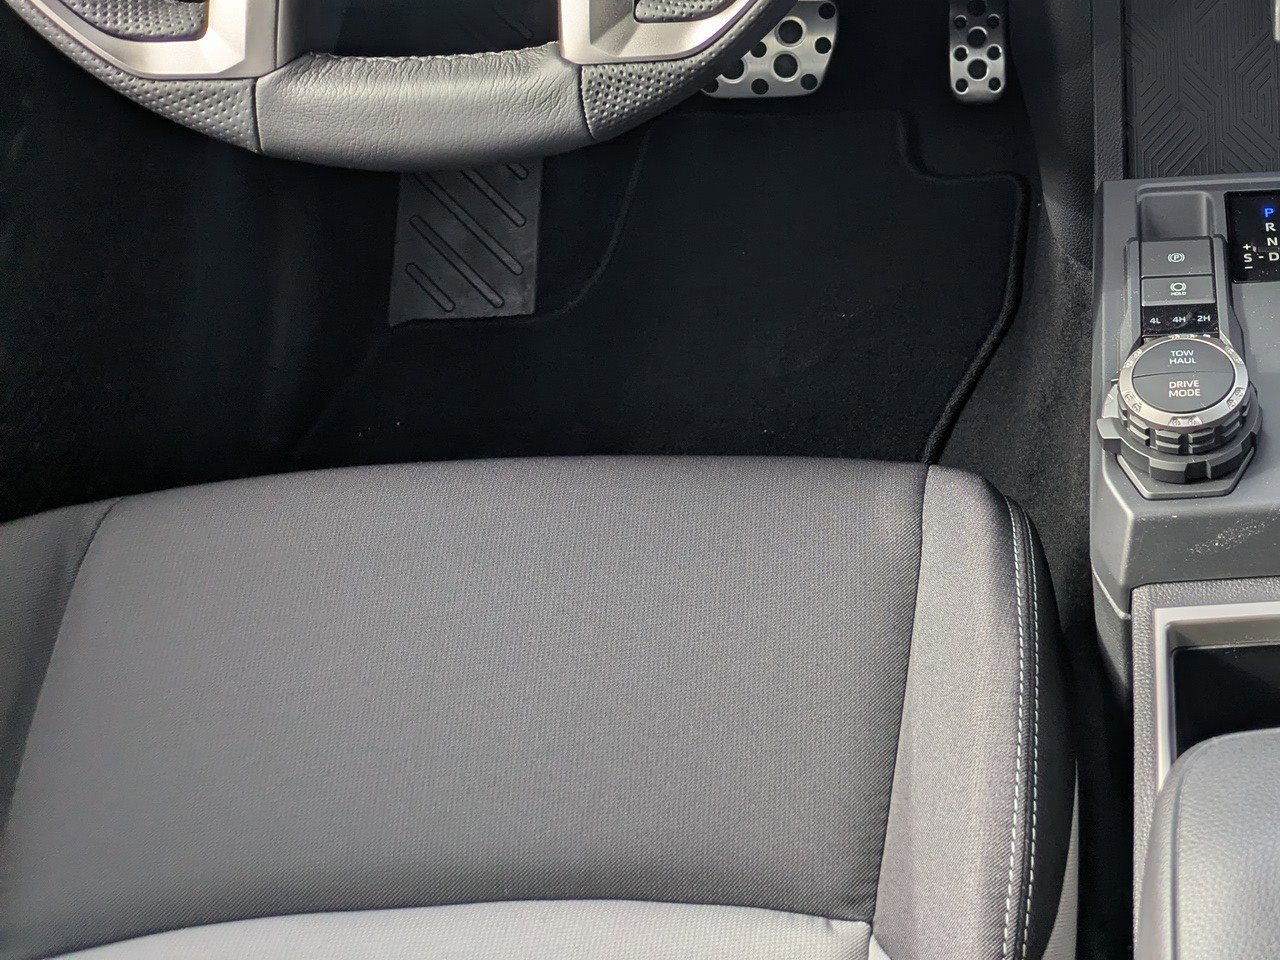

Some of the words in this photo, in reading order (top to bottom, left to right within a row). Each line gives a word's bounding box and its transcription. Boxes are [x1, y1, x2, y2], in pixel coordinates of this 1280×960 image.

[1264, 208, 1274, 217] P
[1265, 222, 1276, 232] R
[1267, 237, 1278, 246] N
[1244, 253, 1252, 263] S
[1268, 252, 1280, 261] D
[1169, 380, 1199, 388] DRIVE
[1168, 389, 1201, 398] MODE
